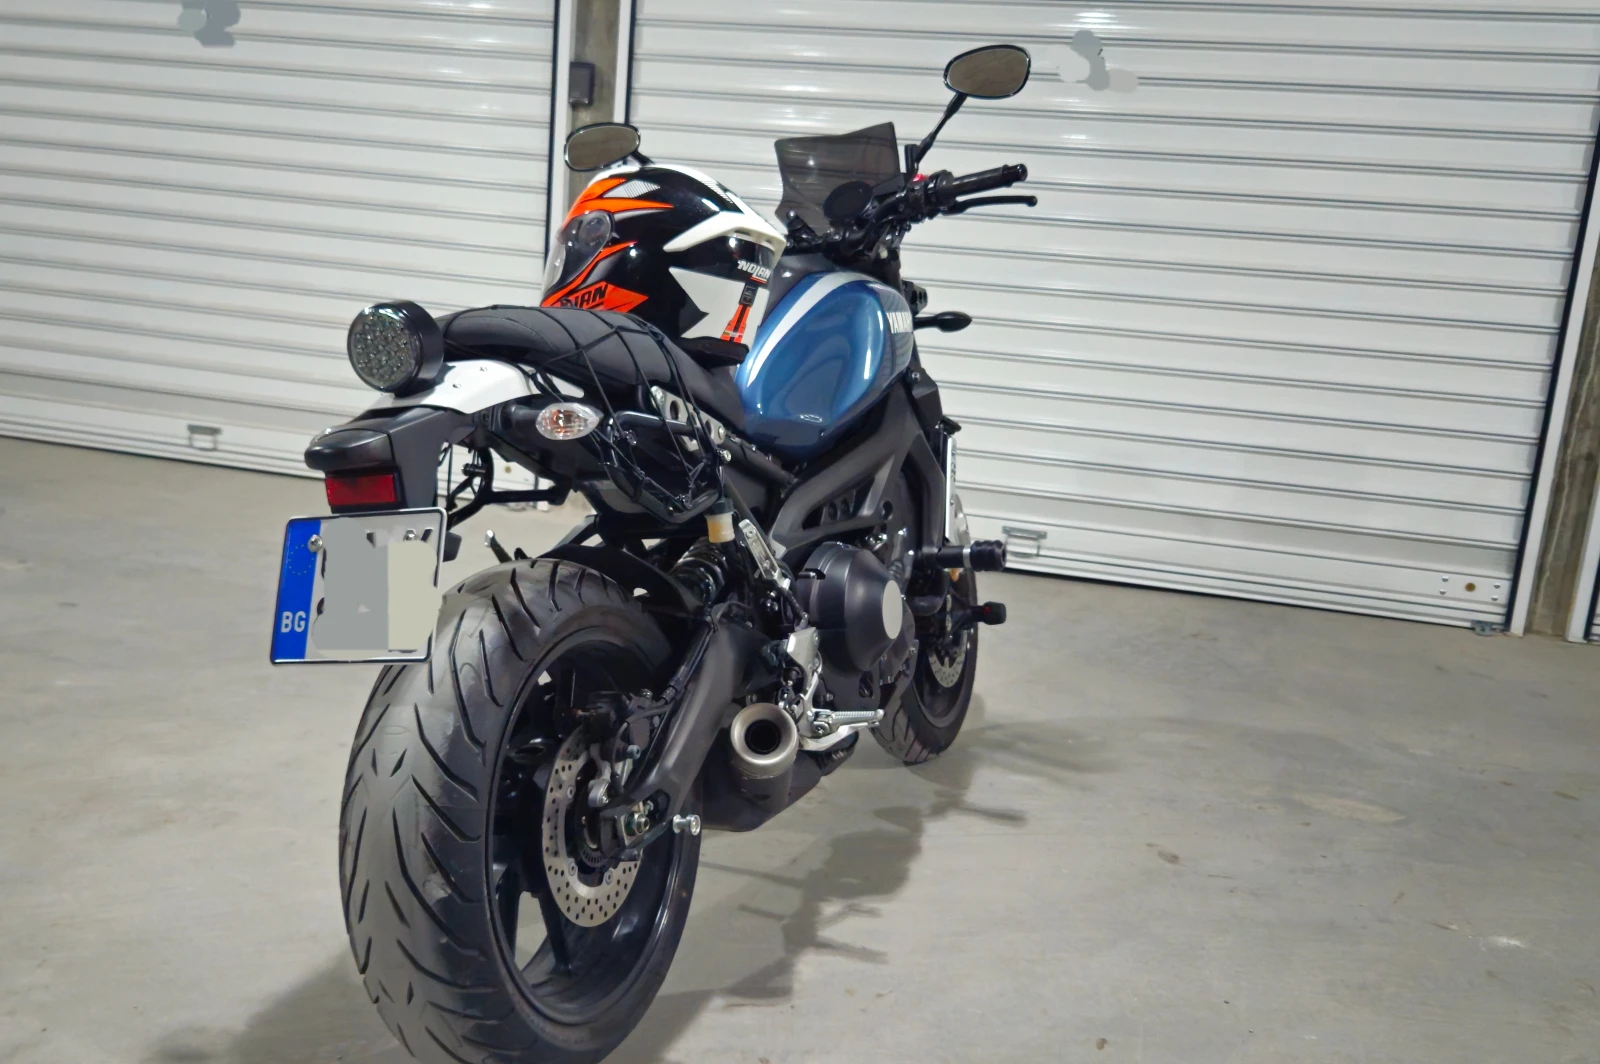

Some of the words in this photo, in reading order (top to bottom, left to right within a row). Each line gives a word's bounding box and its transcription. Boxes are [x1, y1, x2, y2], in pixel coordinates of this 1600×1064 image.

[737, 259, 772, 282] NOLAN
[886, 311, 913, 334] YAMA
[281, 610, 307, 633] BG
